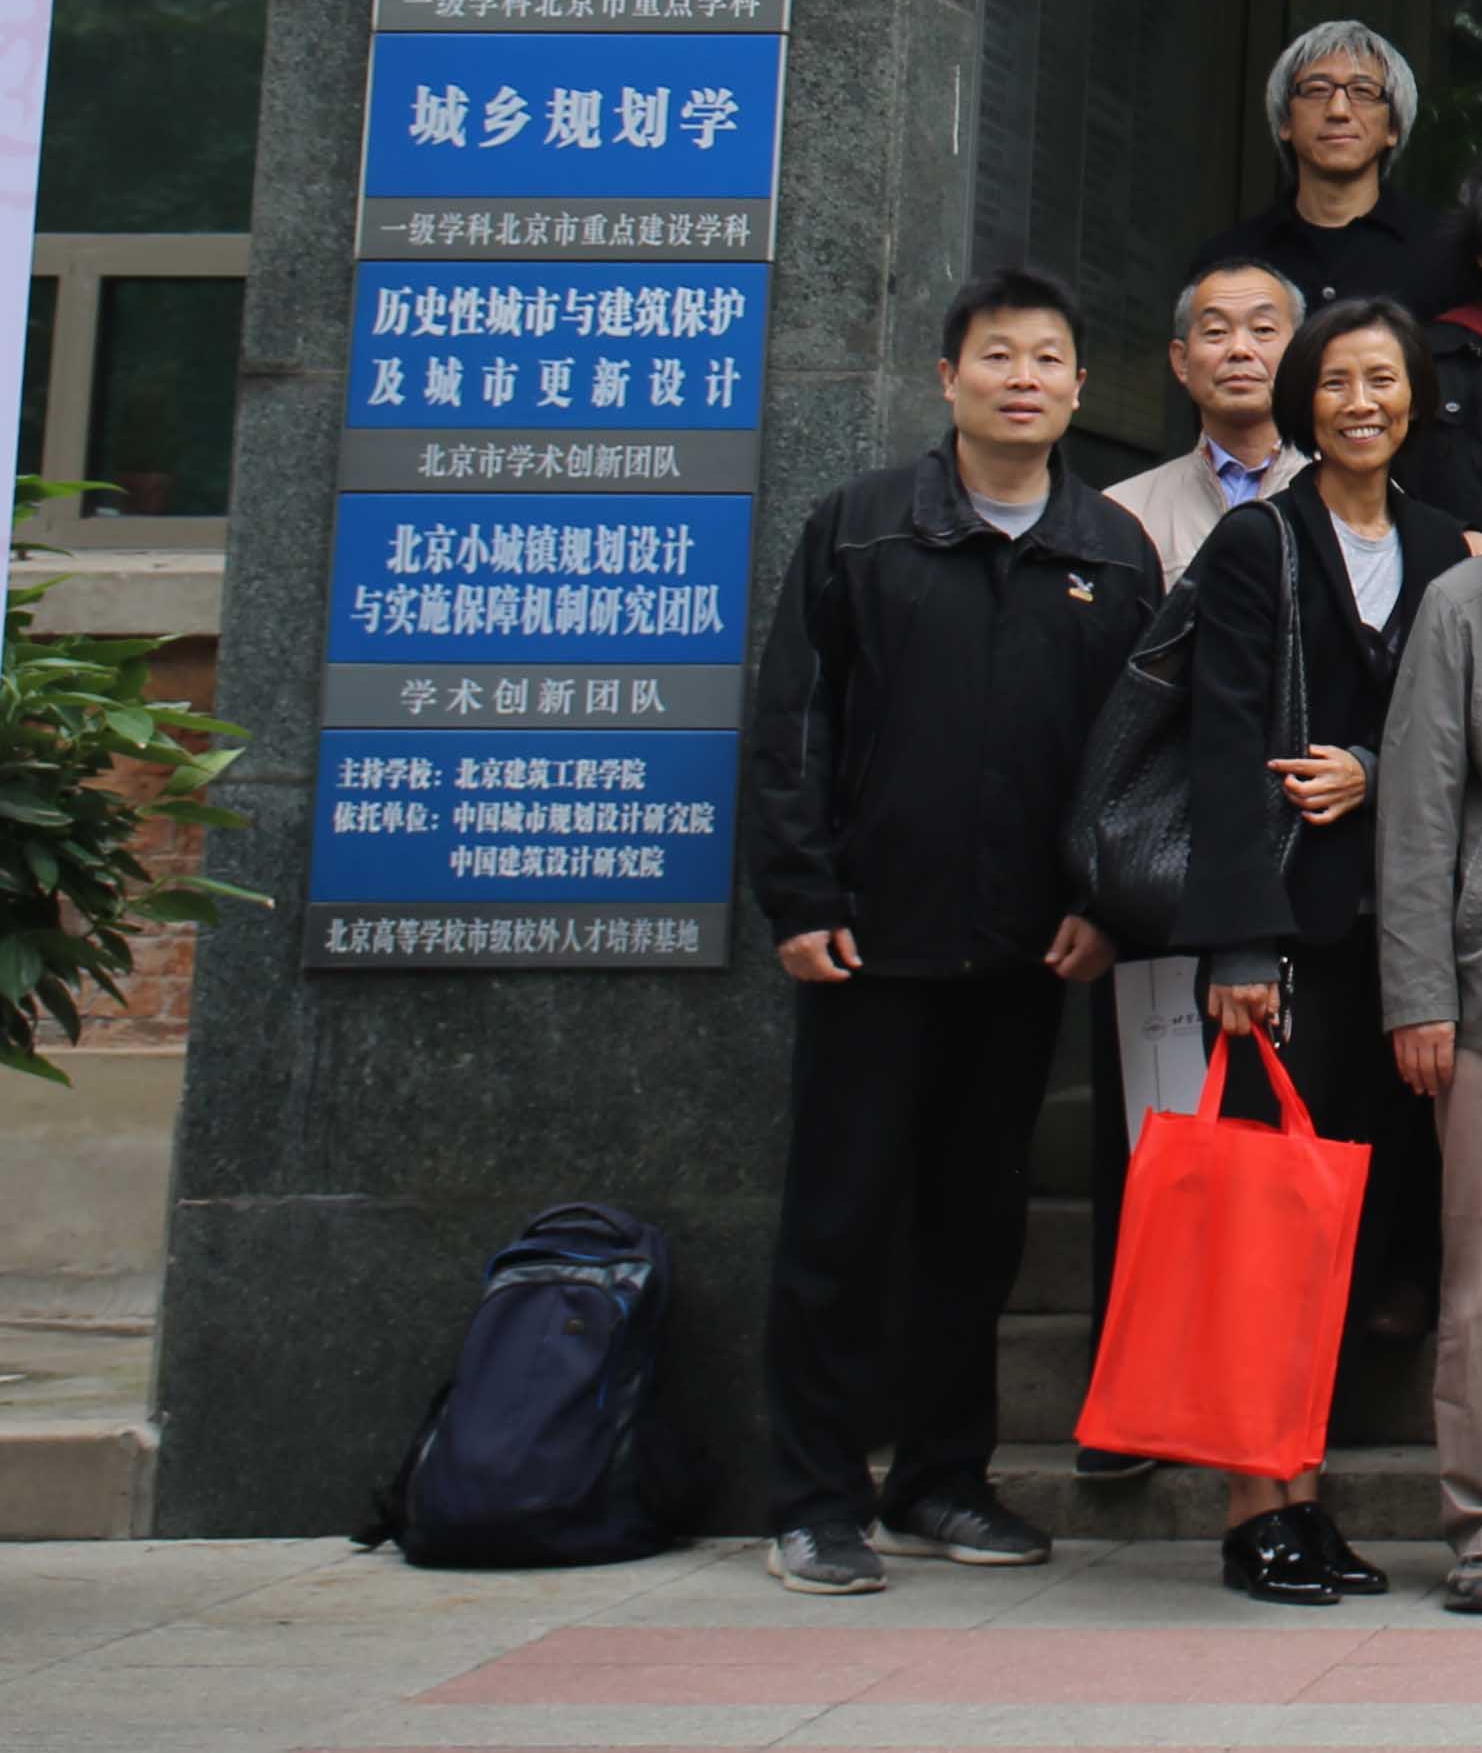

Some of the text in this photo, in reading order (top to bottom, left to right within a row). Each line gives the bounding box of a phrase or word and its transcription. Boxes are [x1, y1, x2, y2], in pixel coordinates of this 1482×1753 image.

[409, 84, 740, 149] 城乡规划学
[381, 212, 751, 247] 一级学科北京市重点建设学科
[372, 286, 745, 338] 历史性城市与建筑保护
[367, 356, 741, 409] 及城市更新设计
[418, 444, 681, 478] 北京市学术创新团队
[386, 523, 695, 575] 北京小城镇规划设计
[350, 584, 724, 636] 与实施保障机制研究团队
[400, 678, 665, 715] 学术创新团队
[450, 846, 665, 878] 中国建筑设计研究院
[325, 918, 699, 955] 北京高等学校市级校外人才培养基地
